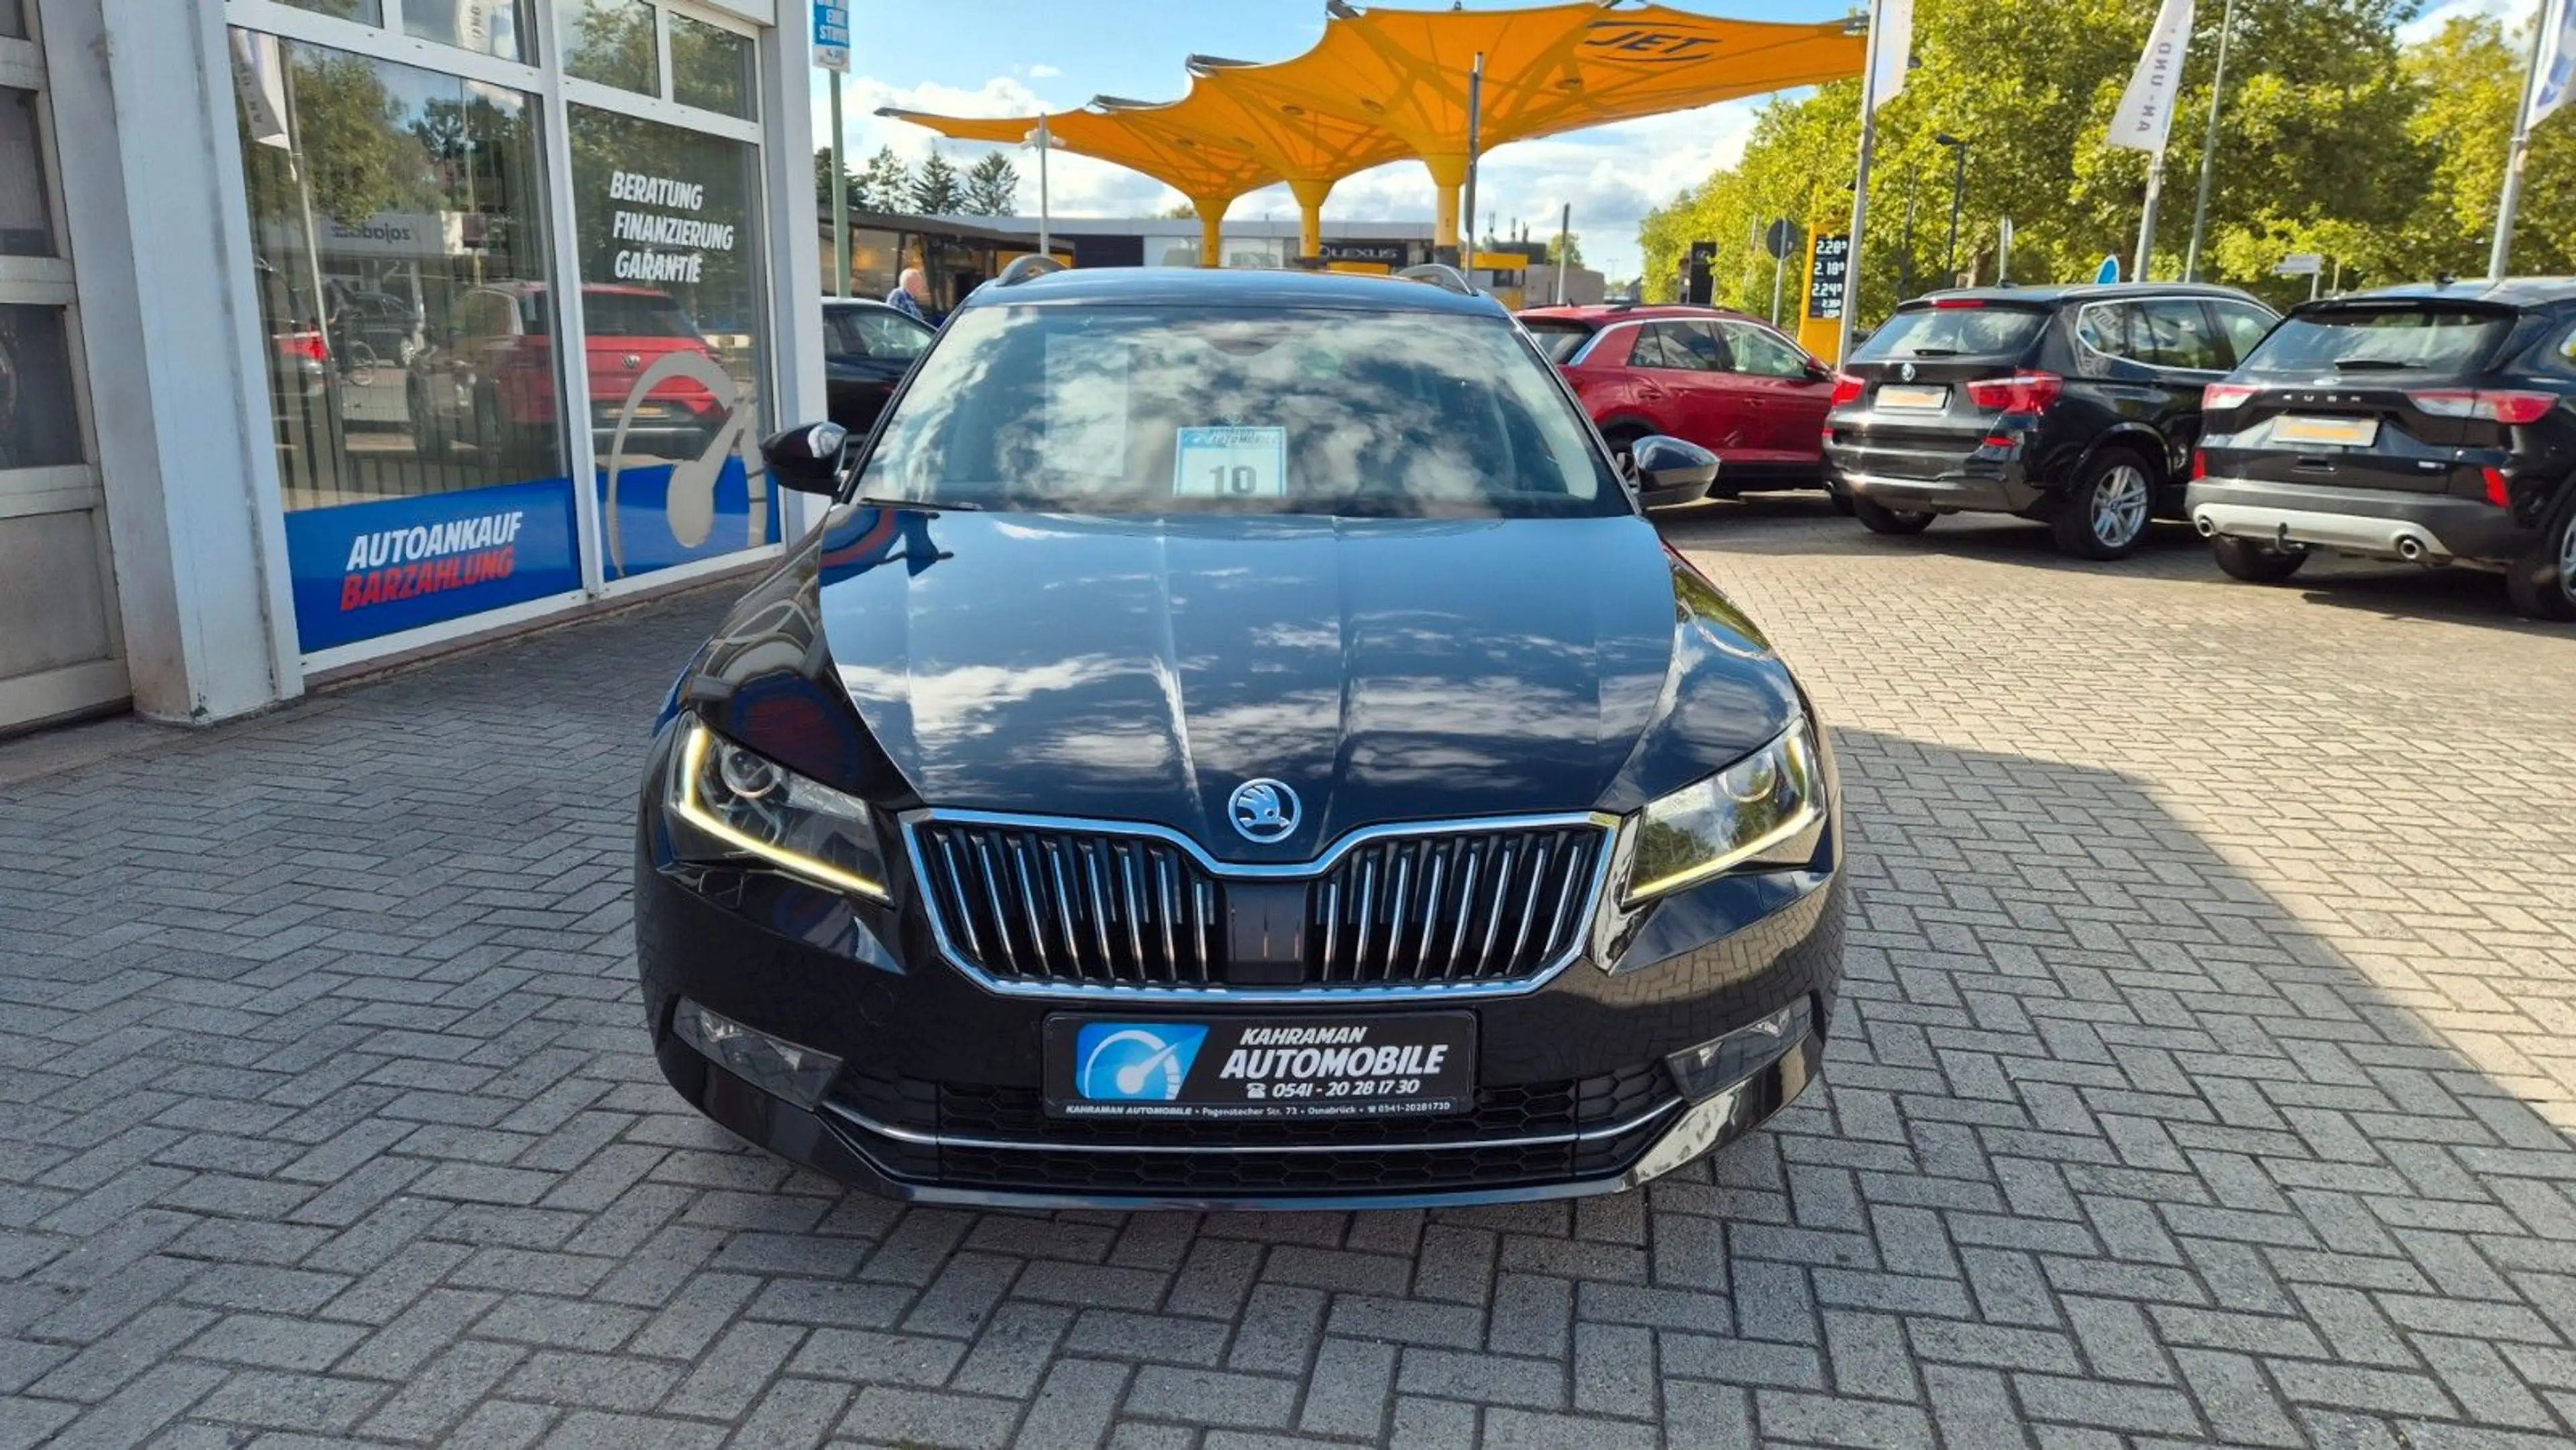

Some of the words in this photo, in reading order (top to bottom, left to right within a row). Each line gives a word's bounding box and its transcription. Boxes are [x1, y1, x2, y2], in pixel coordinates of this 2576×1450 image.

[1584, 31, 1723, 54] JET
[610, 170, 704, 211] BERATUNG
[612, 211, 735, 251] FINANZIERUNG
[614, 249, 702, 283] GARANTIE
[1331, 247, 1399, 258] LEXUS
[1210, 465, 1256, 496] 10
[346, 511, 523, 571] AUTOANKAUF
[341, 545, 516, 611] BARZAHLUNG
[1240, 1026, 1368, 1046] KAHRAMAN
[1218, 1044, 1448, 1079] AUTOMOBILE
[1272, 1082, 1313, 1097] 0541
[1325, 1081, 1350, 1097] 20
[1352, 1080, 1375, 1095] 28
[1377, 1079, 1395, 1095] 17
[1395, 1078, 1420, 1094] 30
[1066, 1105, 1124, 1115] KAHRAMAN
[1126, 1105, 1193, 1115] AUTOMOBILE
